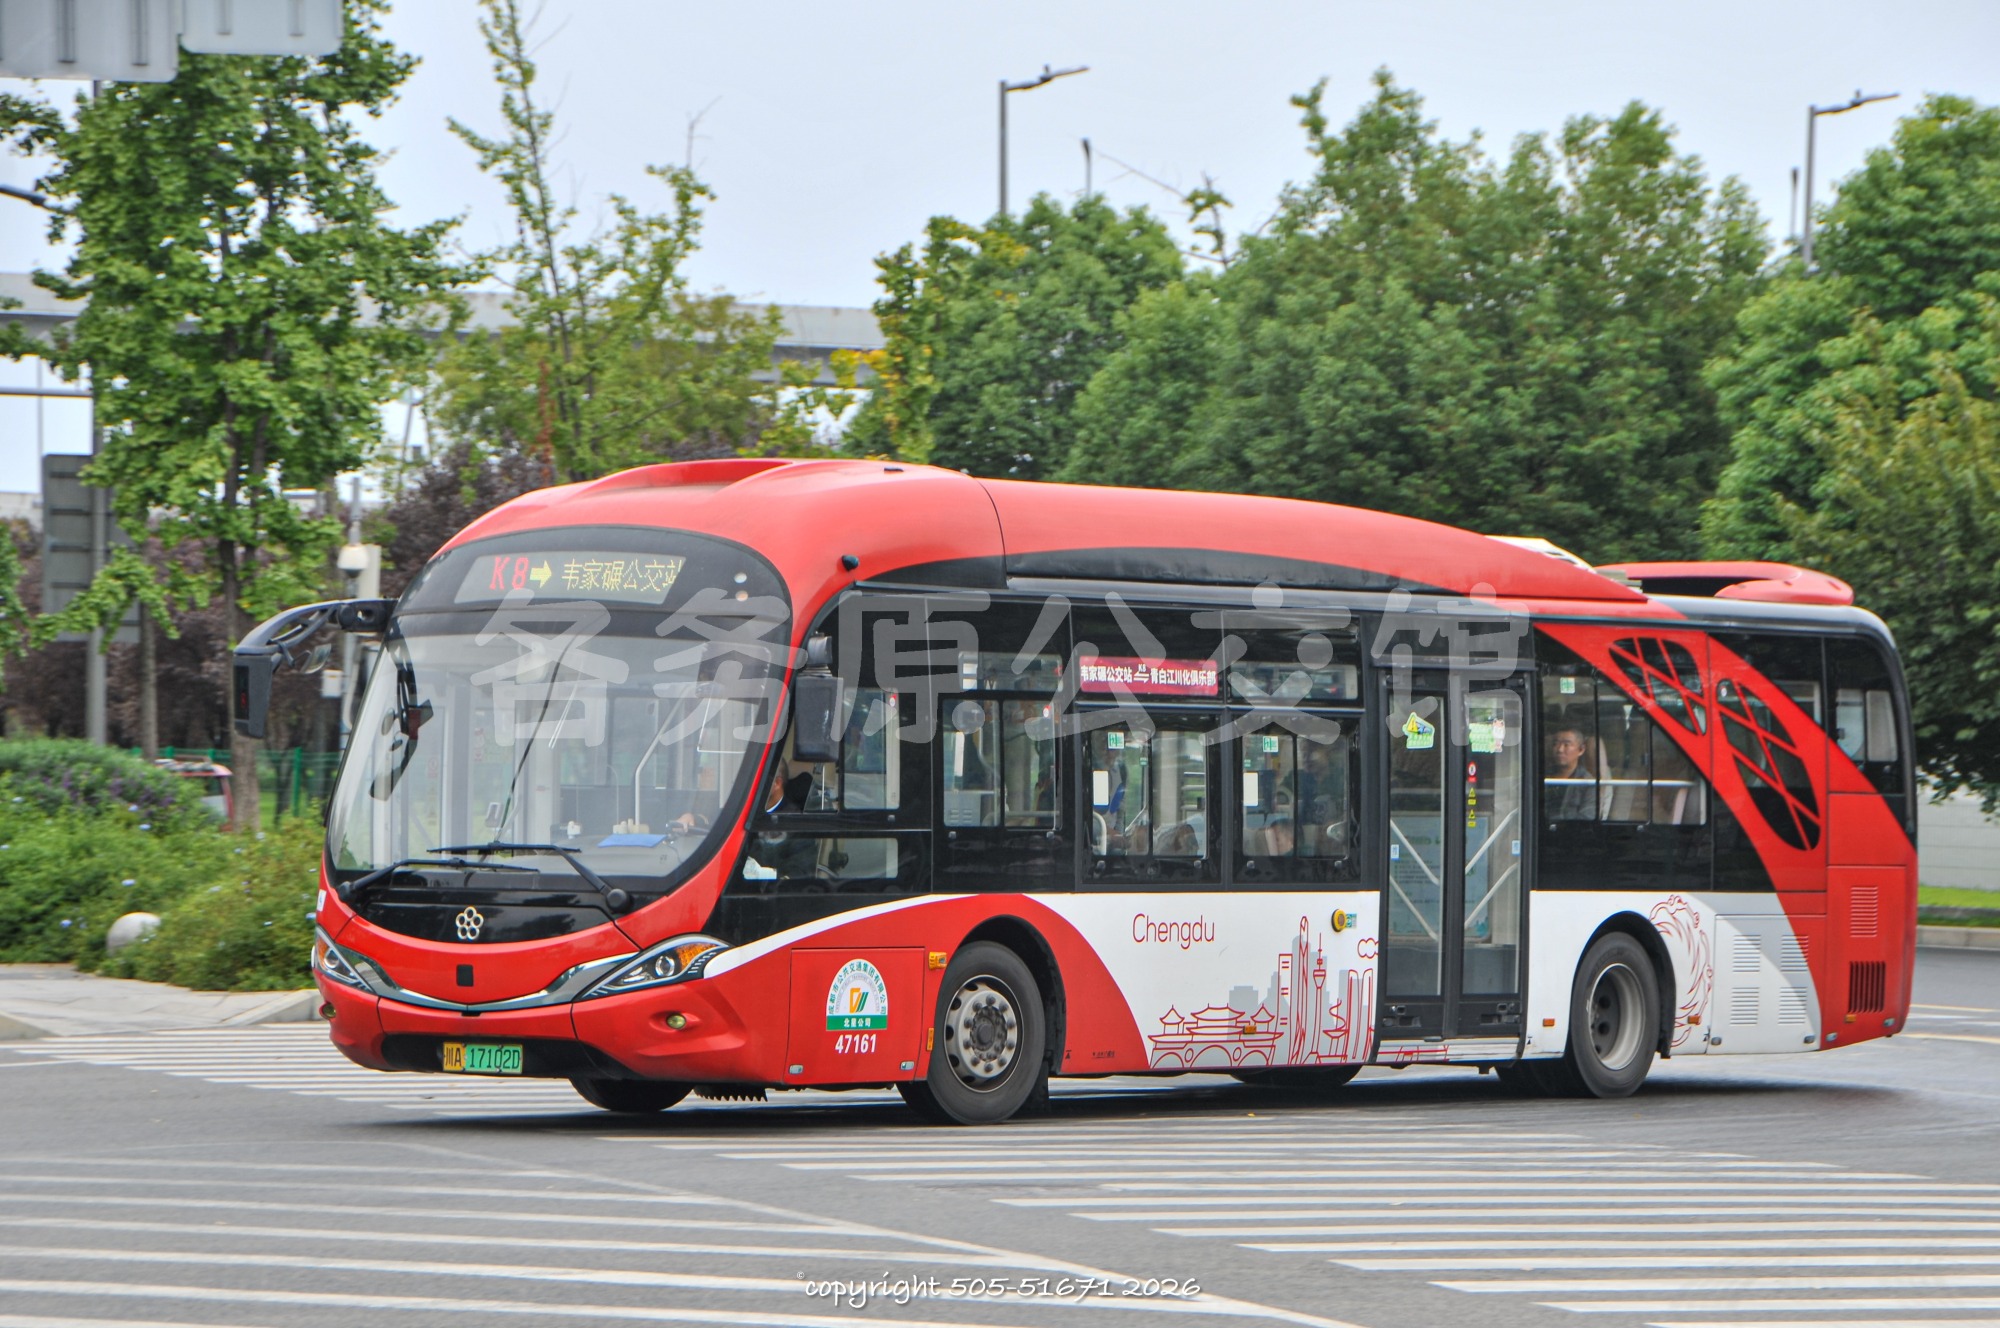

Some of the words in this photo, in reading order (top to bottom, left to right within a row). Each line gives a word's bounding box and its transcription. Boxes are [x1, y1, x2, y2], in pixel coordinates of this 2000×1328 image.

[489, 556, 530, 591] K8
[1132, 913, 1215, 950] Chengdu
[834, 1033, 877, 1054] 47161
